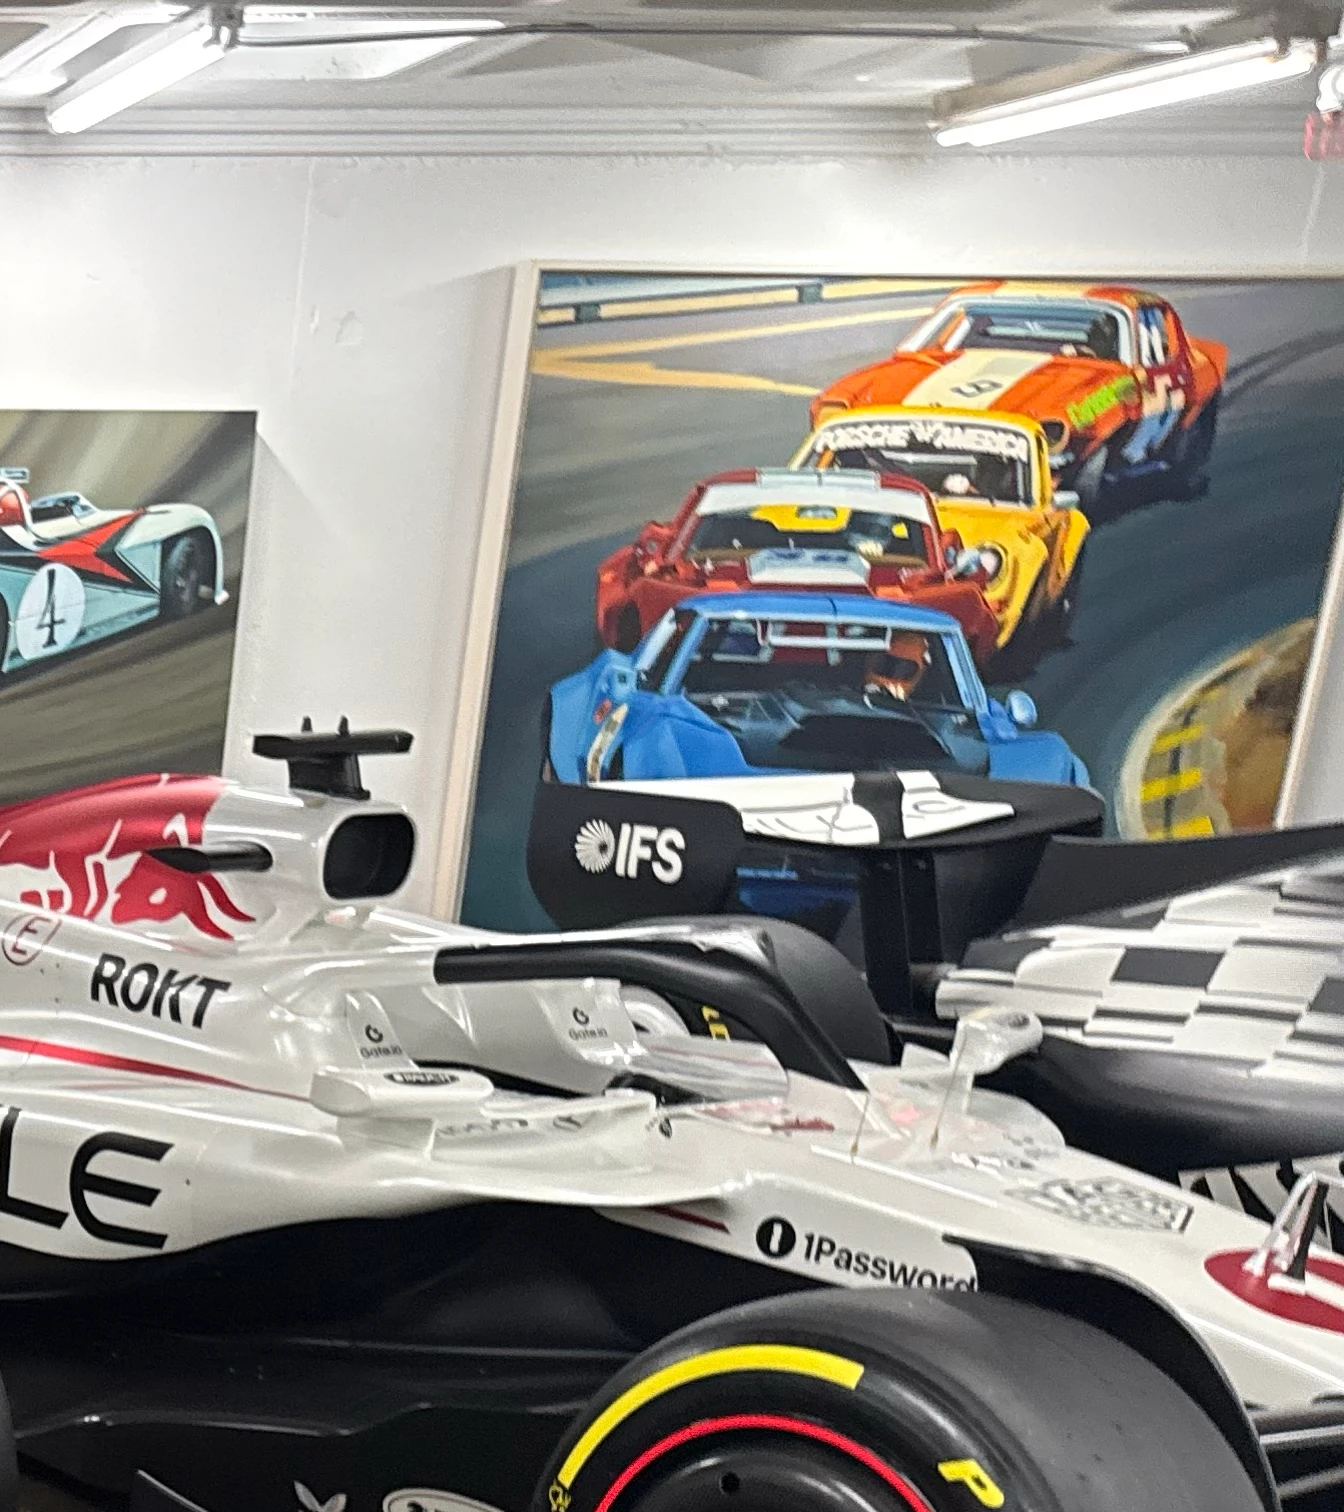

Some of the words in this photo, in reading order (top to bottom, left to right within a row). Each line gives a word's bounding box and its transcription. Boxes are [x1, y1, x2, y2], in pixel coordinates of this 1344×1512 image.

[36, 568, 66, 649] 4
[616, 826, 686, 884] IFS
[90, 952, 231, 1030] ROKT
[937, 1458, 1004, 1509] P
